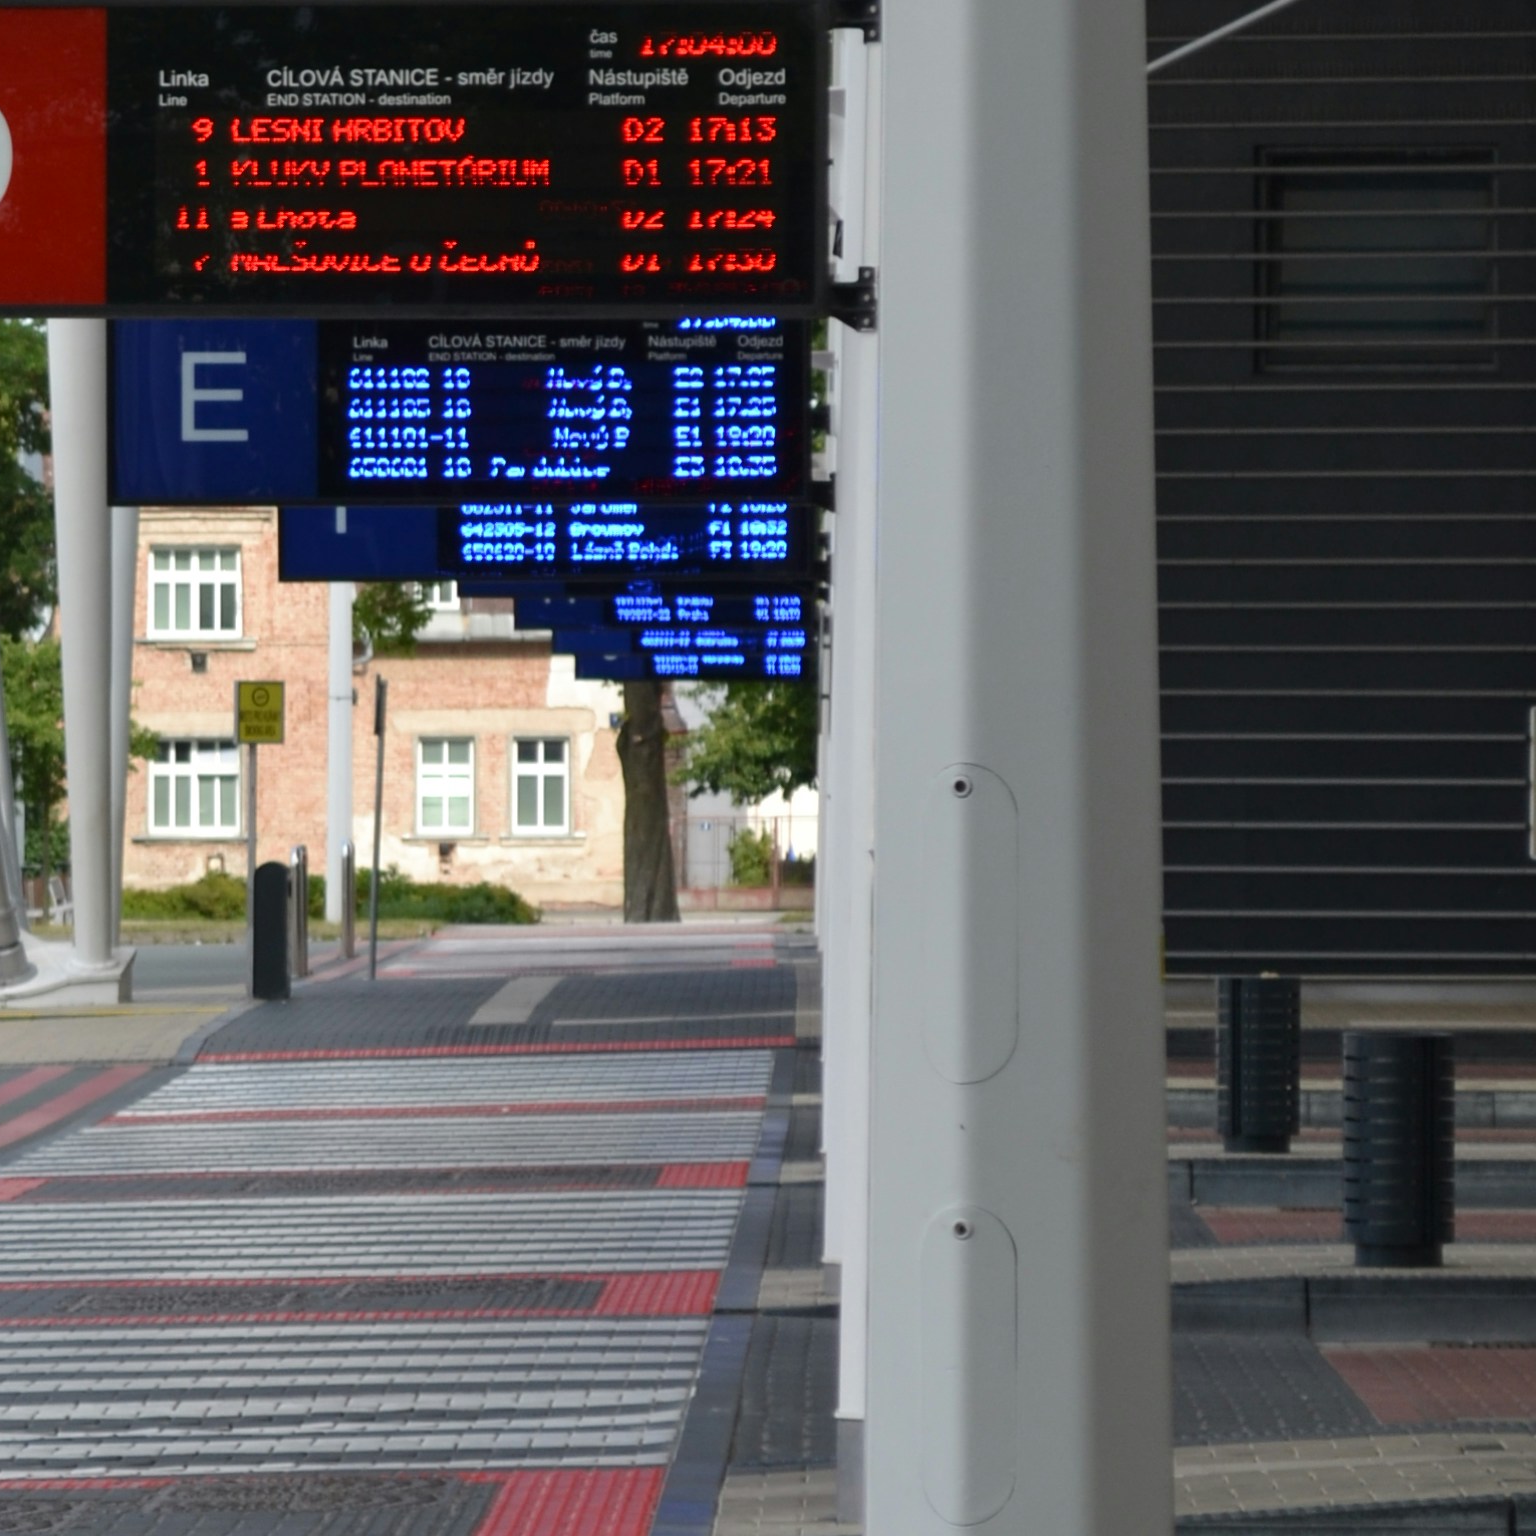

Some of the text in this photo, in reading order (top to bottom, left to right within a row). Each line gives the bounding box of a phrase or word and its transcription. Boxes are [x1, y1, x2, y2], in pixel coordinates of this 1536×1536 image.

[588, 28, 618, 45] čas
[589, 48, 613, 59] time
[158, 69, 210, 88] Linka
[266, 66, 345, 87] CÍLOVÁ
[349, 68, 440, 87] STANICE
[457, 68, 506, 87] směr
[509, 67, 555, 90] jízdy
[588, 67, 690, 90] Nástupiště
[718, 67, 787, 90] Odjezd
[158, 93, 188, 107] Line
[266, 93, 300, 107] END
[302, 93, 367, 107] STATION
[378, 92, 452, 107] destination
[588, 92, 646, 106] Platform
[718, 92, 787, 107] Departure
[192, 118, 214, 143] 9
[230, 118, 324, 143] LESNI
[332, 118, 466, 143] HRBITOV
[688, 117, 777, 142] 17:13
[194, 159, 211, 187] 1
[688, 159, 773, 186] 17:21
[176, 206, 210, 230] 11
[352, 336, 389, 350] Linka
[428, 333, 483, 349] CÍLOVÁ
[485, 335, 547, 349] STANICE
[559, 334, 593, 349] směr
[736, 334, 785, 351] Odjezd
[428, 352, 451, 362] END
[452, 352, 498, 362] STATION
[505, 351, 556, 362] destination
[181, 351, 249, 442] E
